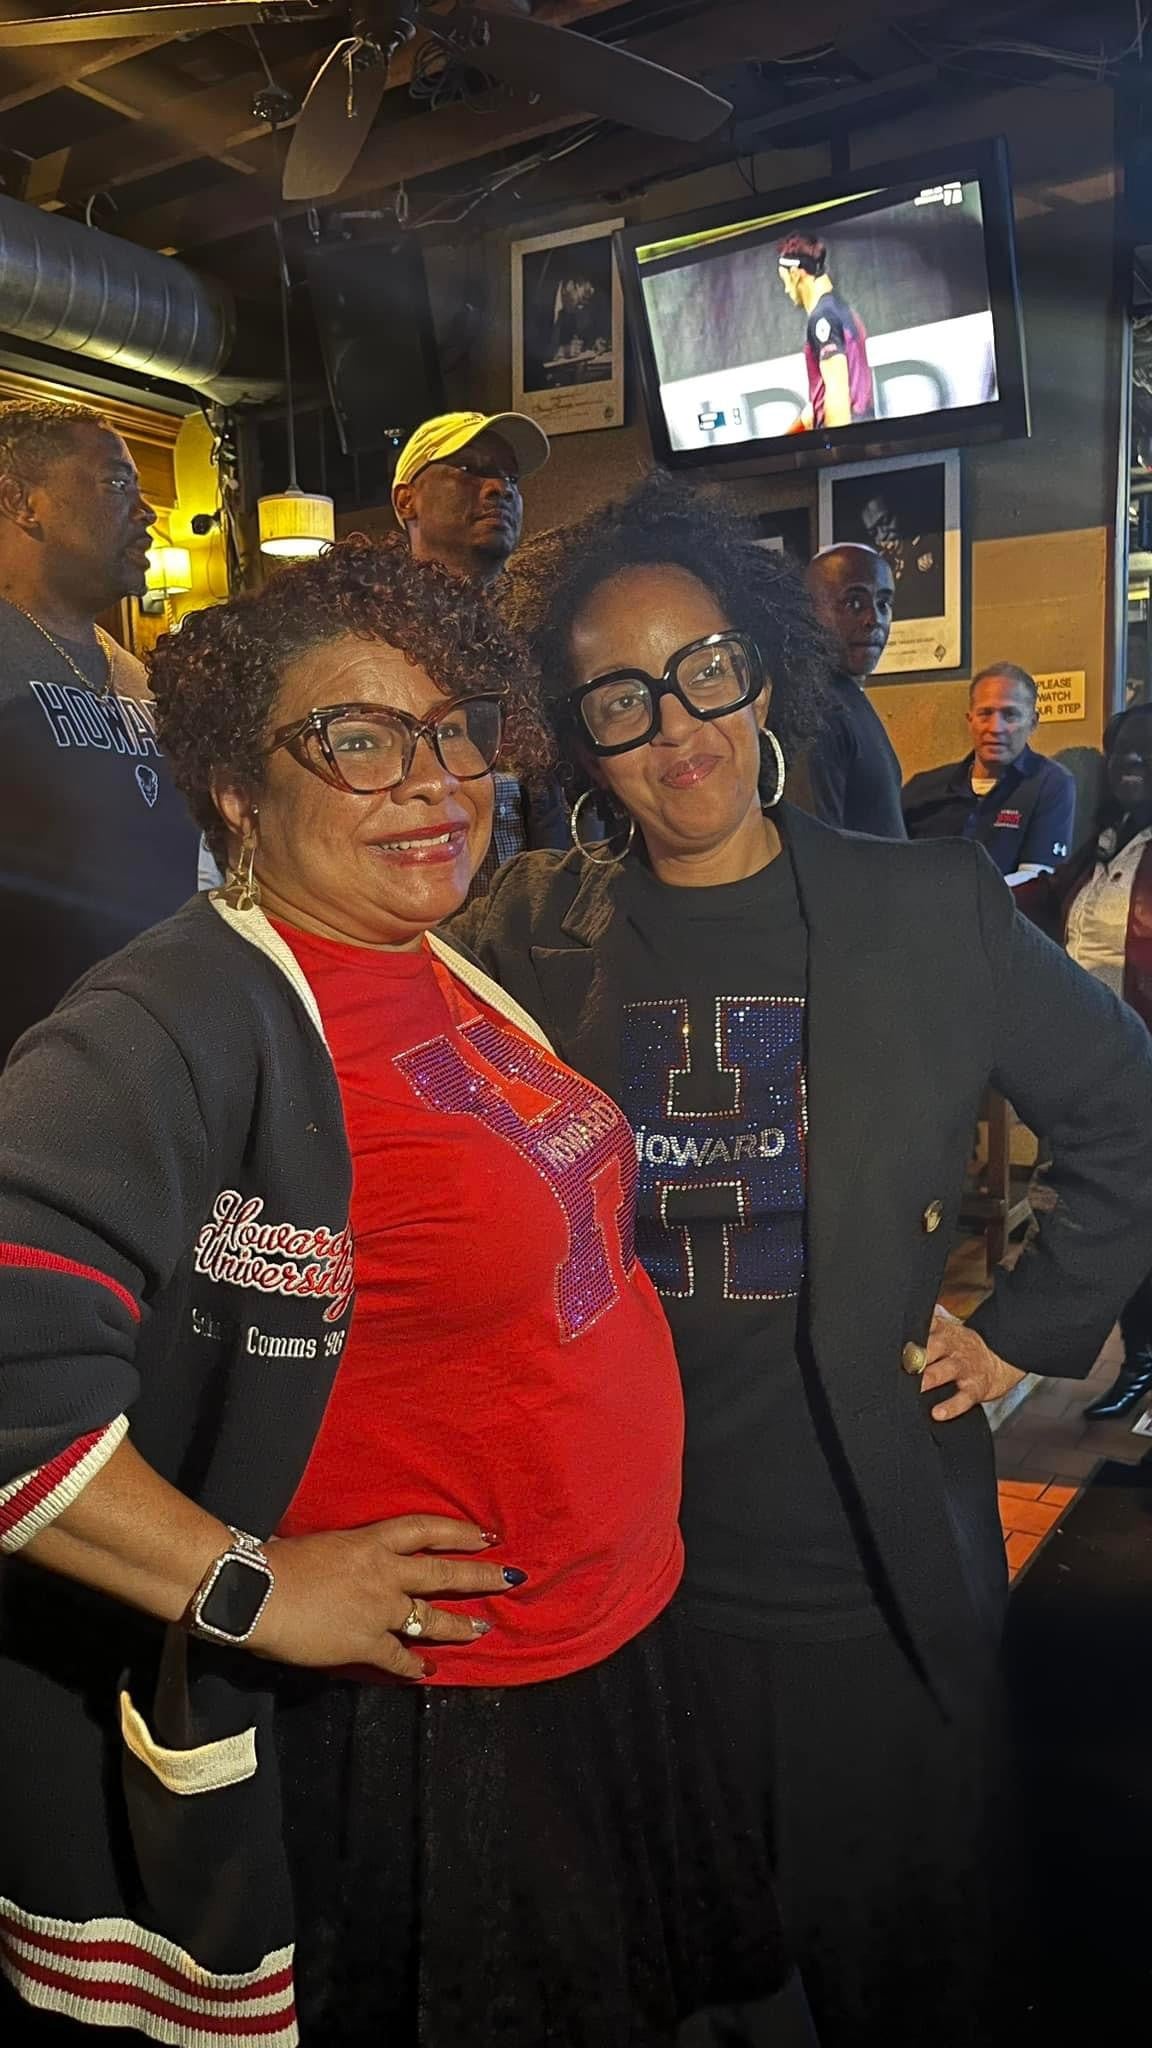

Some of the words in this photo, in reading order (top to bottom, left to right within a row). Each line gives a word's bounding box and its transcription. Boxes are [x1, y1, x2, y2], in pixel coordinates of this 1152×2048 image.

[1057, 702, 1081, 714] STEP
[537, 1100, 618, 1173] HOWARD
[213, 1189, 354, 1259] Howard
[195, 1224, 355, 1322] University
[247, 1326, 317, 1359] Comms
[323, 1329, 346, 1357] '96
